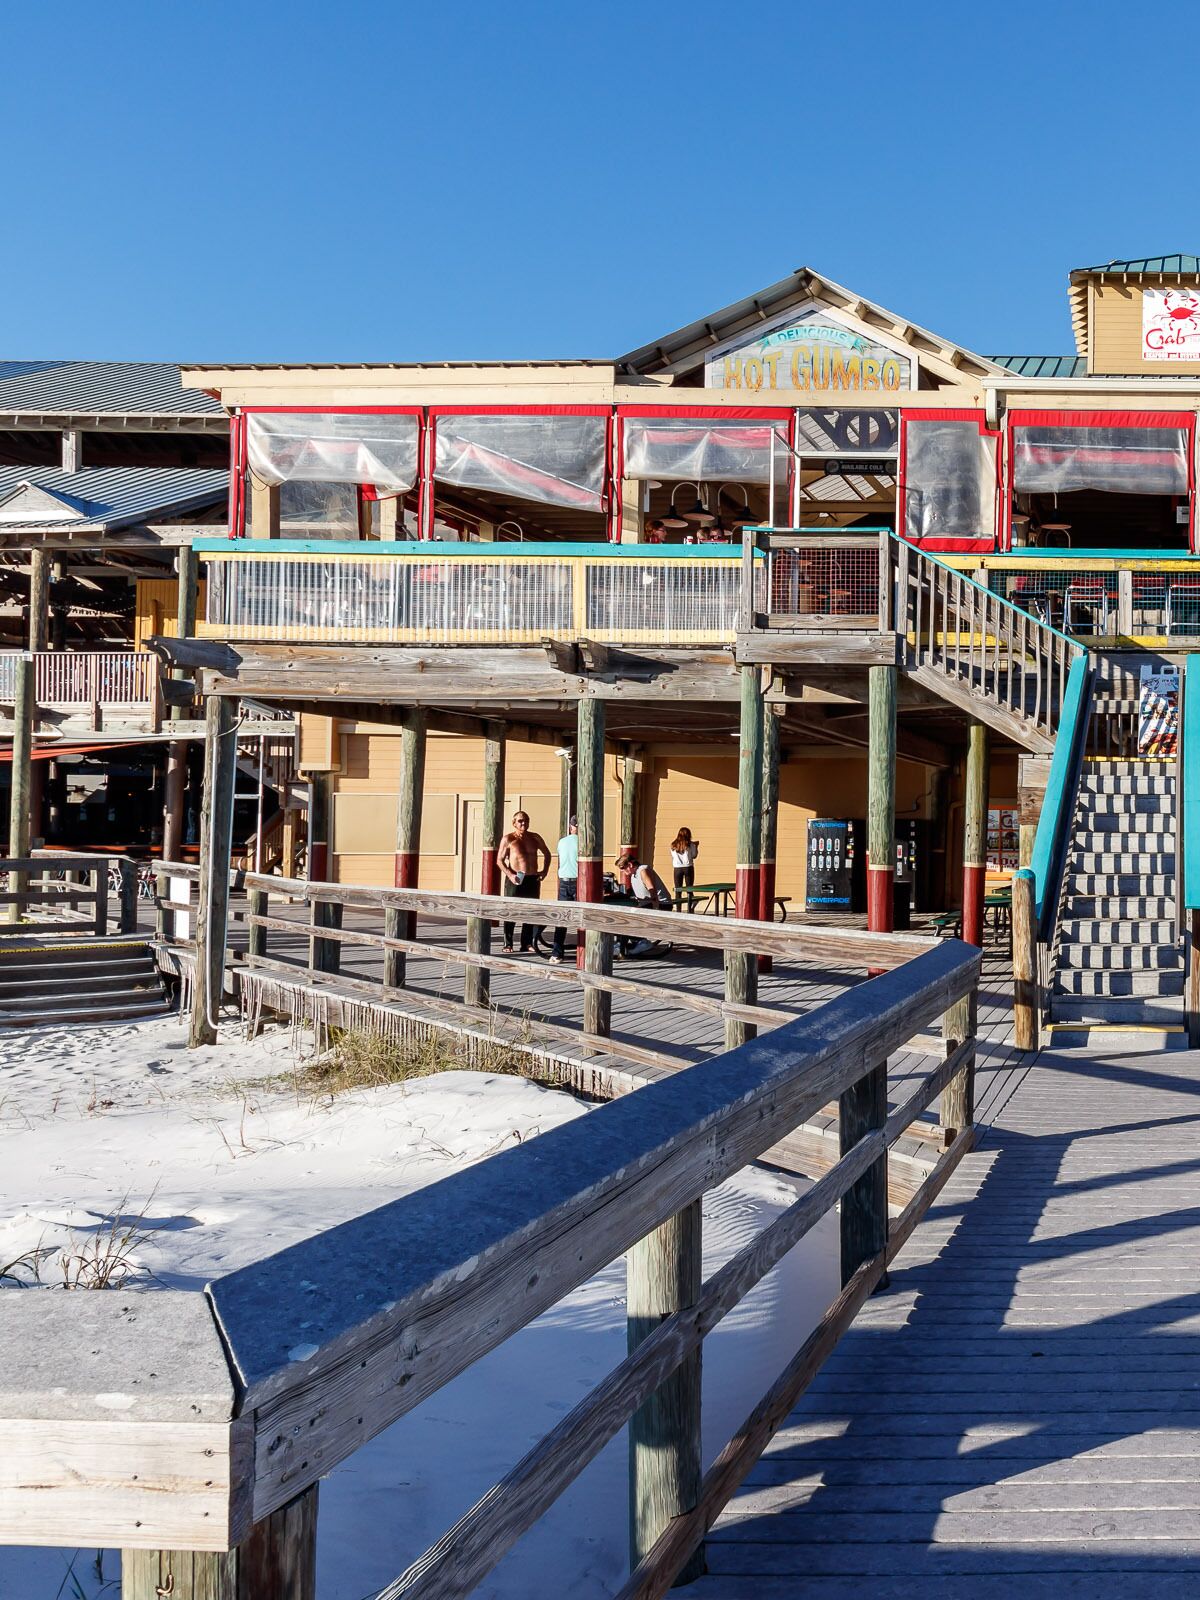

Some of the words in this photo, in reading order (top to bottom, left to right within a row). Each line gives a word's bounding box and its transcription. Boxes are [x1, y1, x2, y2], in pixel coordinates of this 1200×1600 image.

[777, 328, 848, 342] DELICIOUS
[724, 351, 784, 390] HOT
[790, 345, 900, 391] GUMBO
